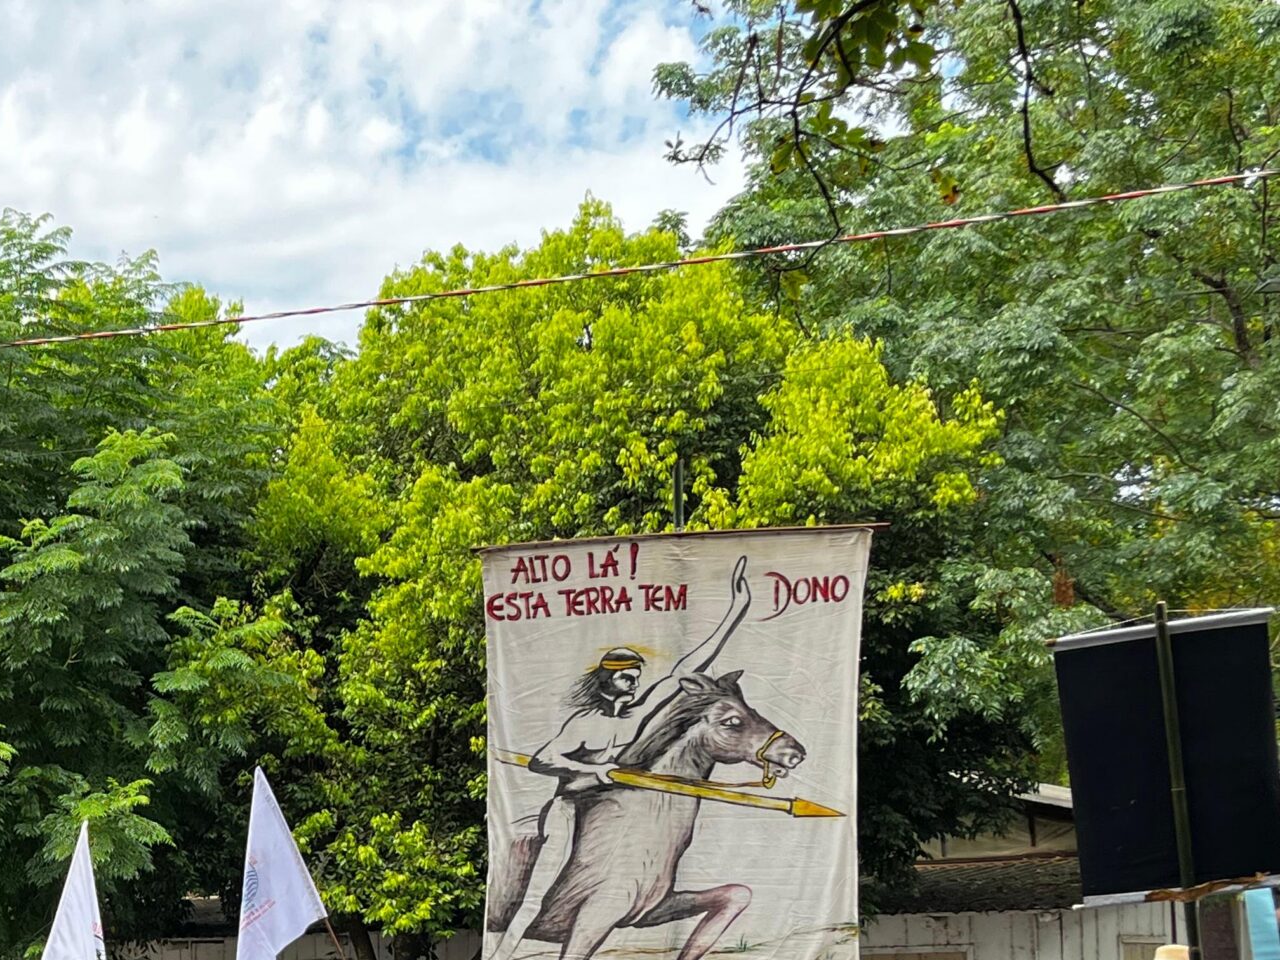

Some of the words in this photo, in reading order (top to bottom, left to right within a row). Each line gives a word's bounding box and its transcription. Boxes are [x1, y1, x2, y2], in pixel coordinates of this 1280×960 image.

[511, 553, 571, 585] ALTO
[486, 592, 551, 622] ESTA
[558, 585, 633, 618] TERRA
[638, 583, 688, 612] TEM
[758, 571, 850, 622] DONO
